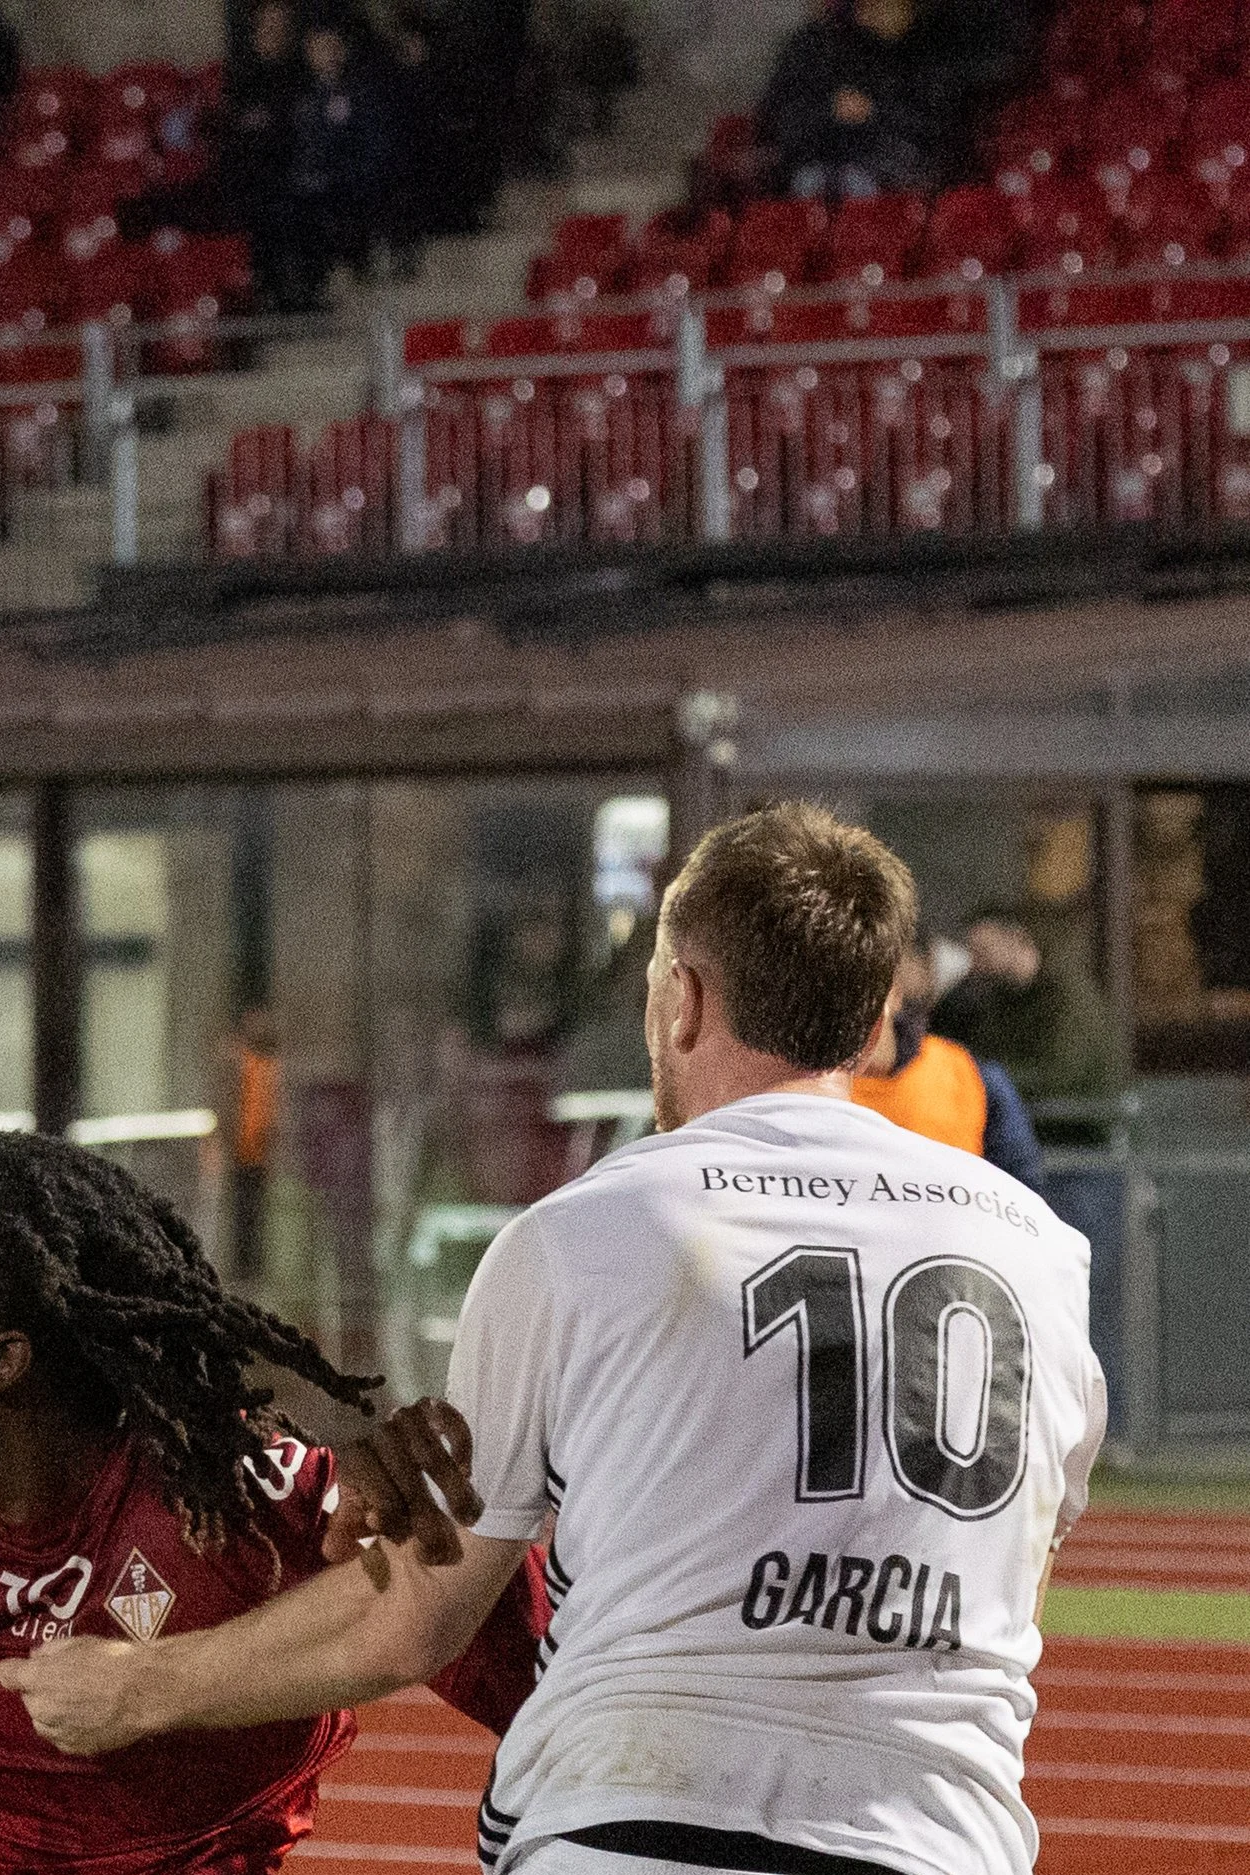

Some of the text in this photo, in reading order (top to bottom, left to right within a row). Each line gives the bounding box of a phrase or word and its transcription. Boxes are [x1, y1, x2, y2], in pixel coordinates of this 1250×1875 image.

[699, 1166, 1041, 1238] Berney Associés
[742, 1244, 1033, 1522] 10
[741, 1551, 962, 1650] GARCIA
